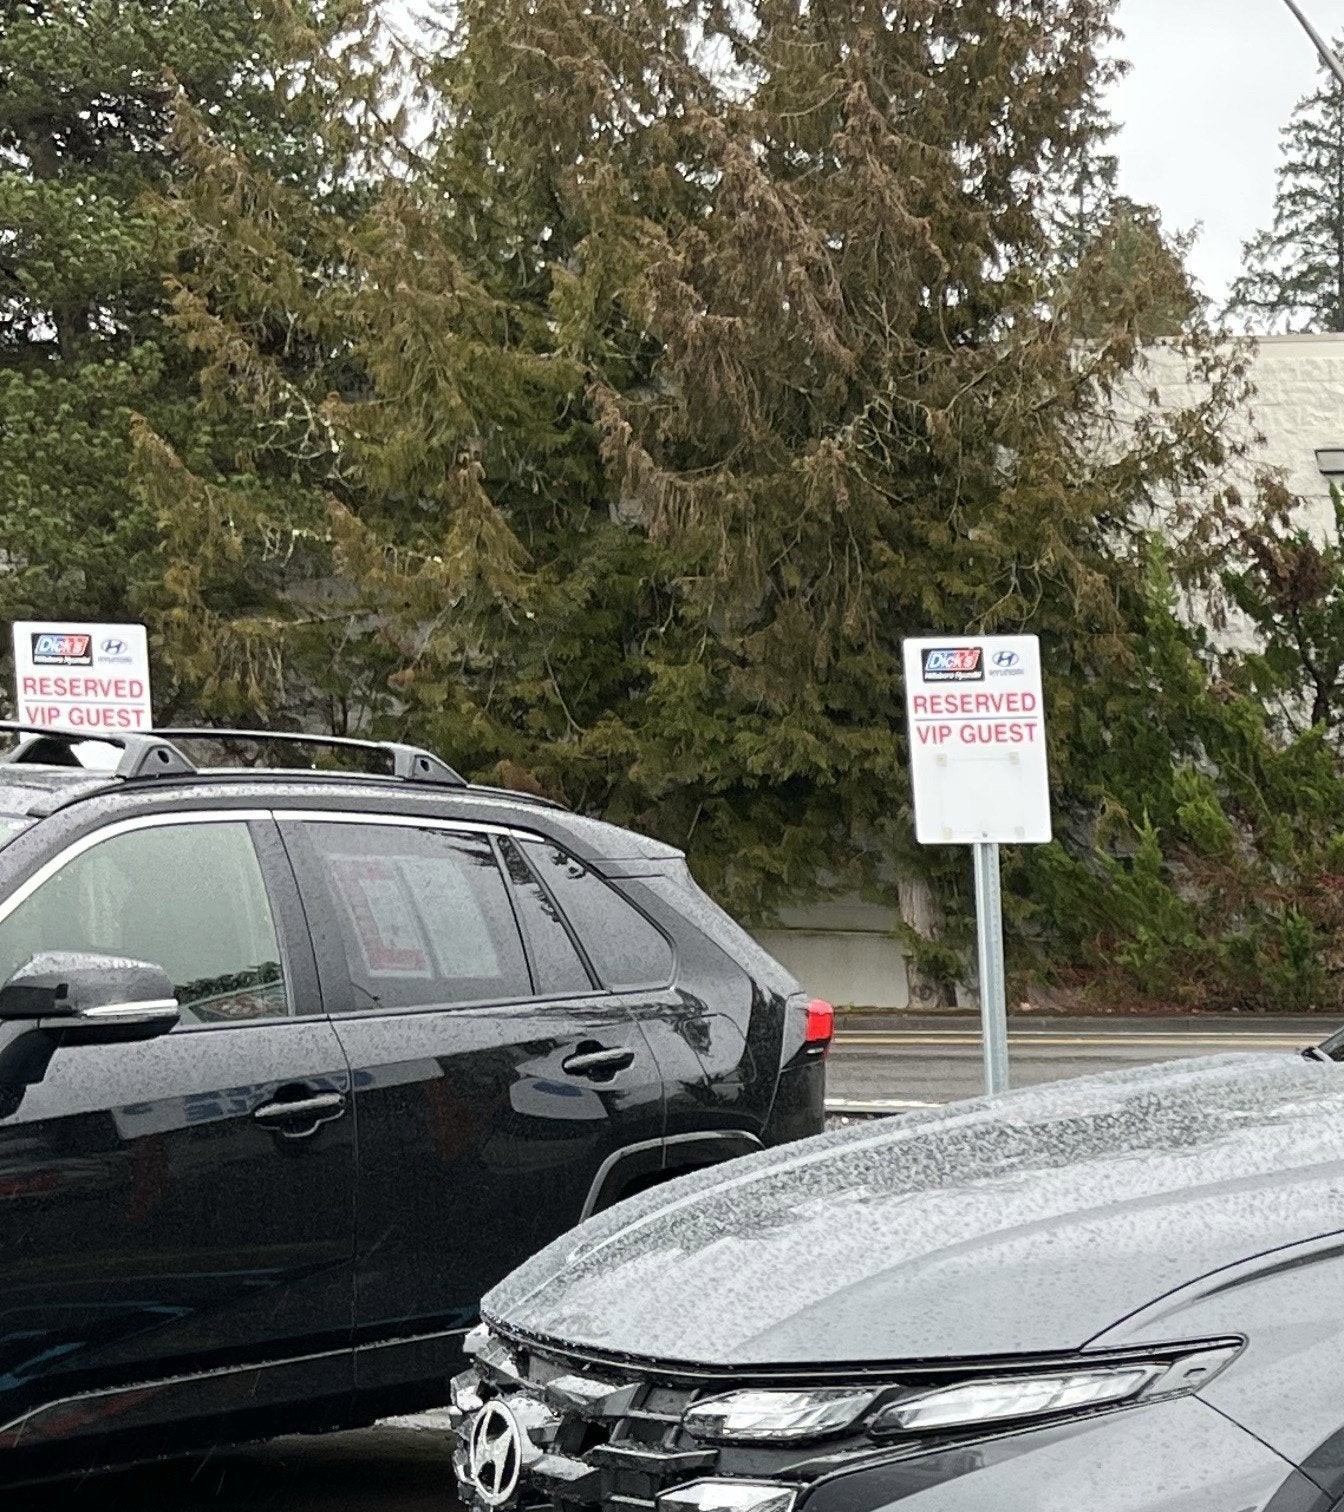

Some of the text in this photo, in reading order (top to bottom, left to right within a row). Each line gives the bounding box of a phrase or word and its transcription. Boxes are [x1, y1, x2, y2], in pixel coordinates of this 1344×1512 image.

[23, 677, 143, 698] RESERVED
[913, 692, 1036, 714] RESERVED
[26, 706, 144, 727] VIP GUEST
[916, 723, 1037, 744] VIP GUEST
